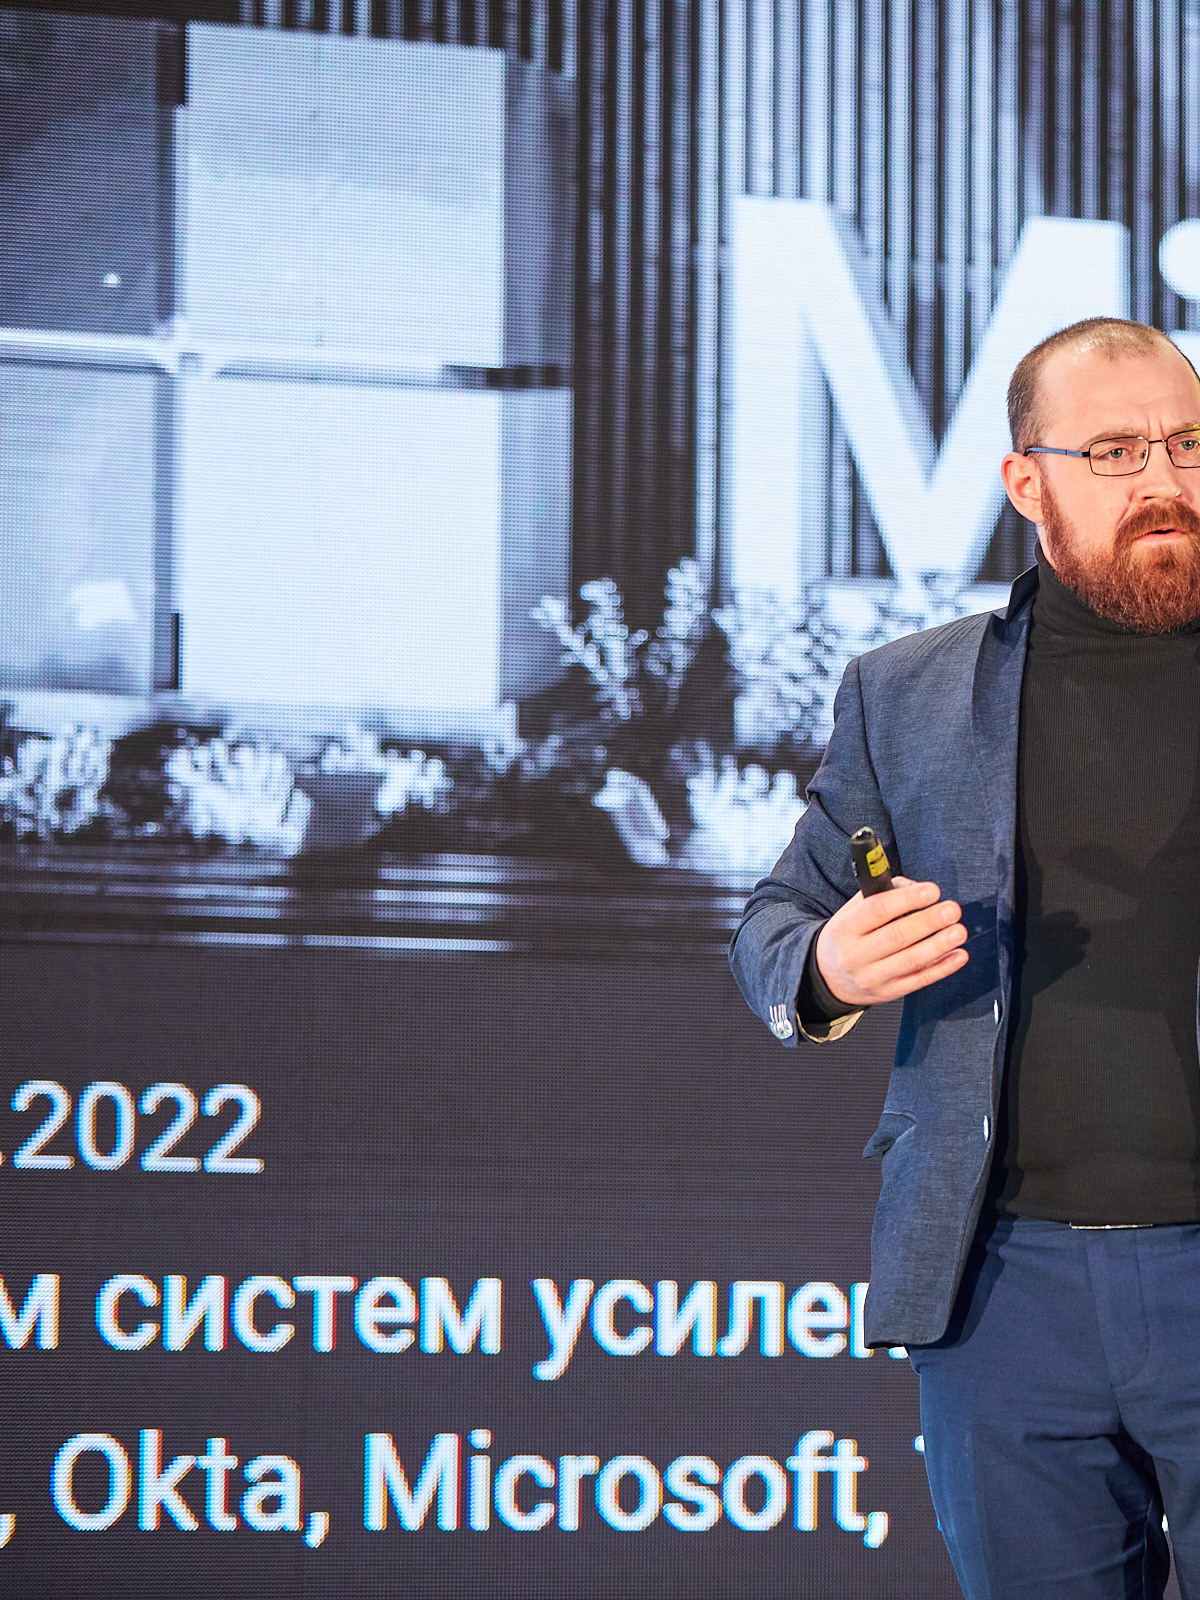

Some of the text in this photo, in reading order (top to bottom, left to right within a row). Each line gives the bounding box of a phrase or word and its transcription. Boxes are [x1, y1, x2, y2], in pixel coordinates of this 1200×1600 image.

[96, 1274, 504, 1355] систем
[50, 1428, 330, 1548] Okta,
[363, 1428, 890, 1549] Microsoft,
